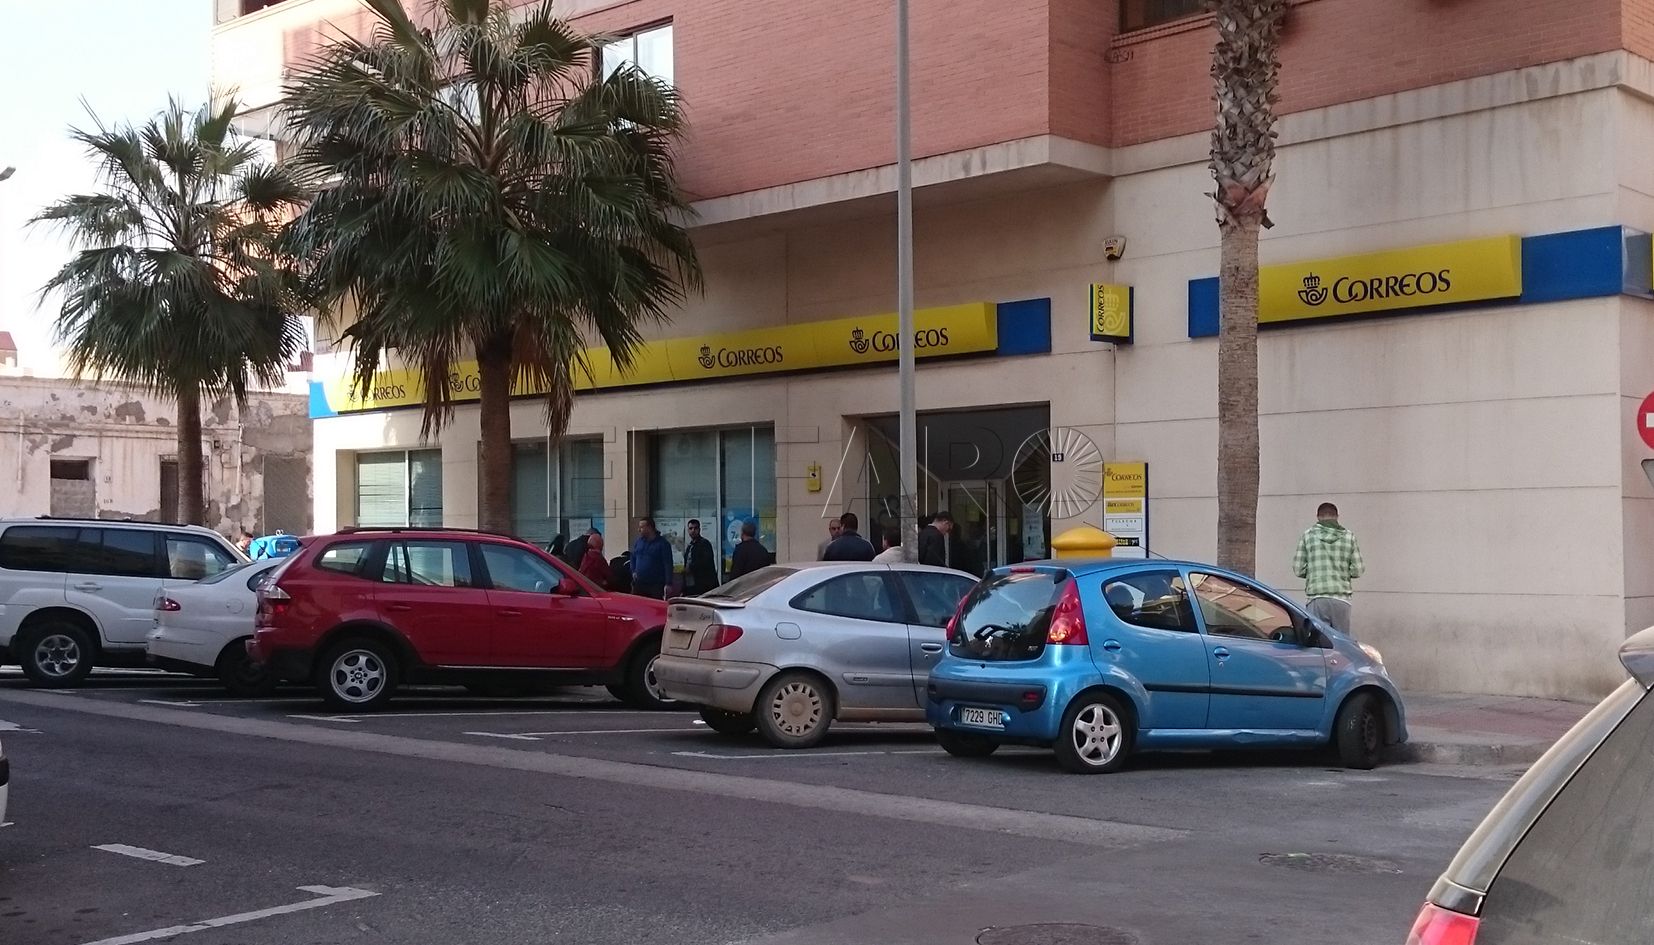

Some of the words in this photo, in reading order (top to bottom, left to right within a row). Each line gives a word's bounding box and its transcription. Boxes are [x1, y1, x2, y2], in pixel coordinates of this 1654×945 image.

[1332, 269, 1451, 304] CORREOS
[1096, 283, 1105, 333] CORREOS
[872, 328, 949, 352] COEOS
[717, 346, 783, 368] CORREOS
[965, 709, 984, 723] 7229
